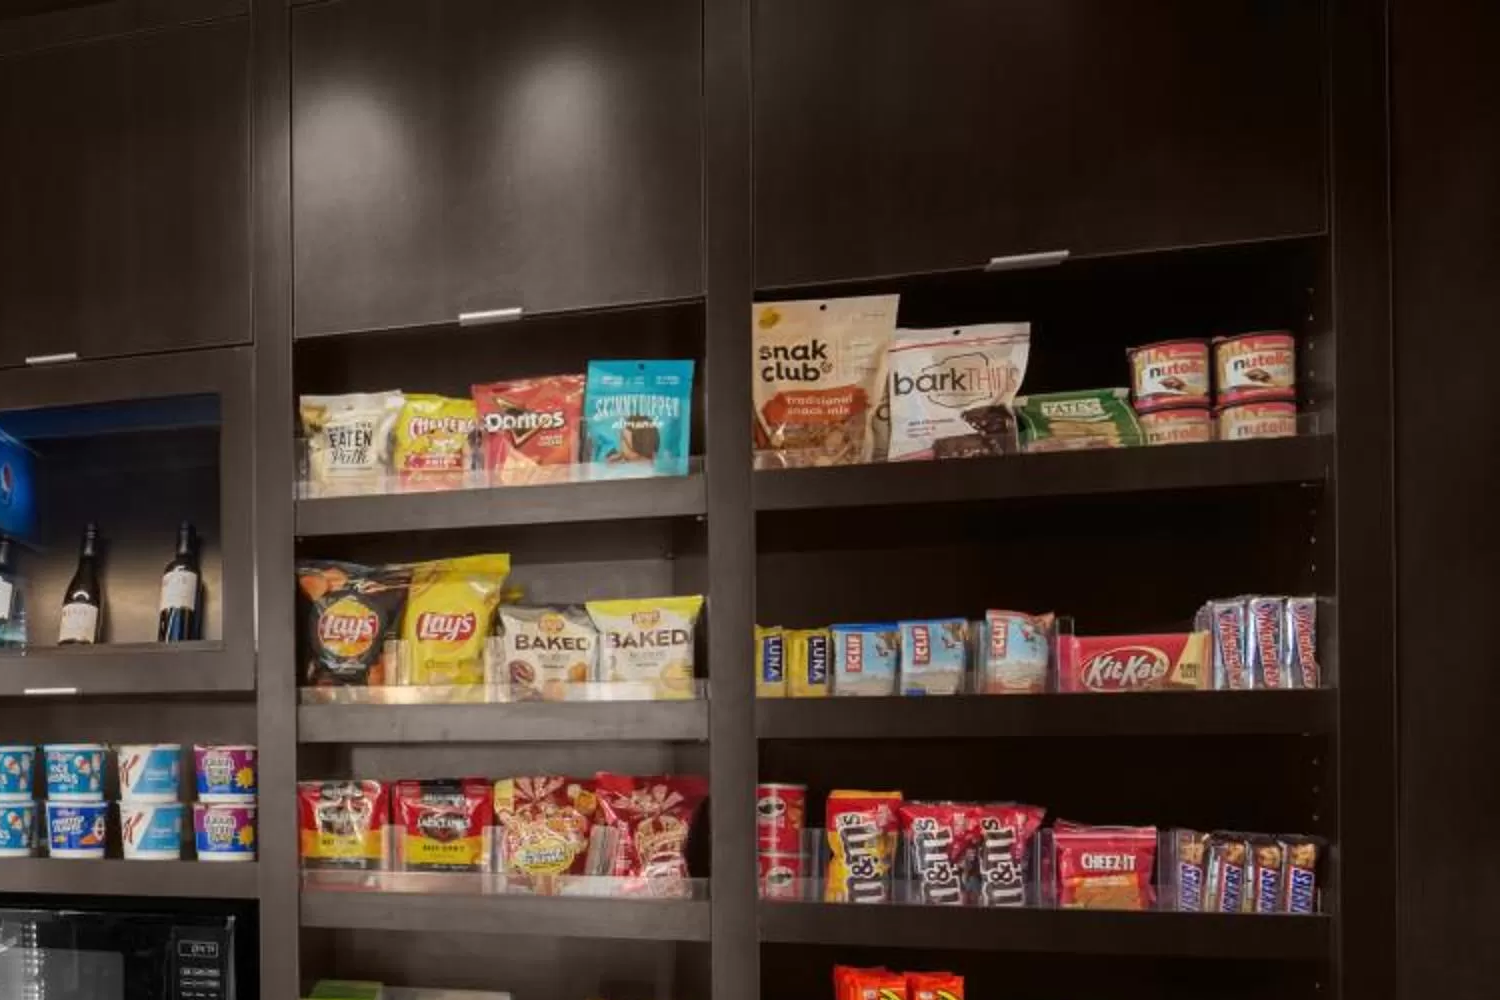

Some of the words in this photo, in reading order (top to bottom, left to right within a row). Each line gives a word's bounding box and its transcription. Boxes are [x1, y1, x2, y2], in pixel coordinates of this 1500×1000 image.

[759, 339, 828, 362] snak
[762, 360, 821, 382] club
[485, 410, 565, 433] Doritos
[328, 429, 373, 449] EATEN
[419, 612, 473, 641] Lay's
[606, 629, 689, 649] BAKED
[768, 636, 781, 682] LUNA
[811, 638, 825, 682] LUNA
